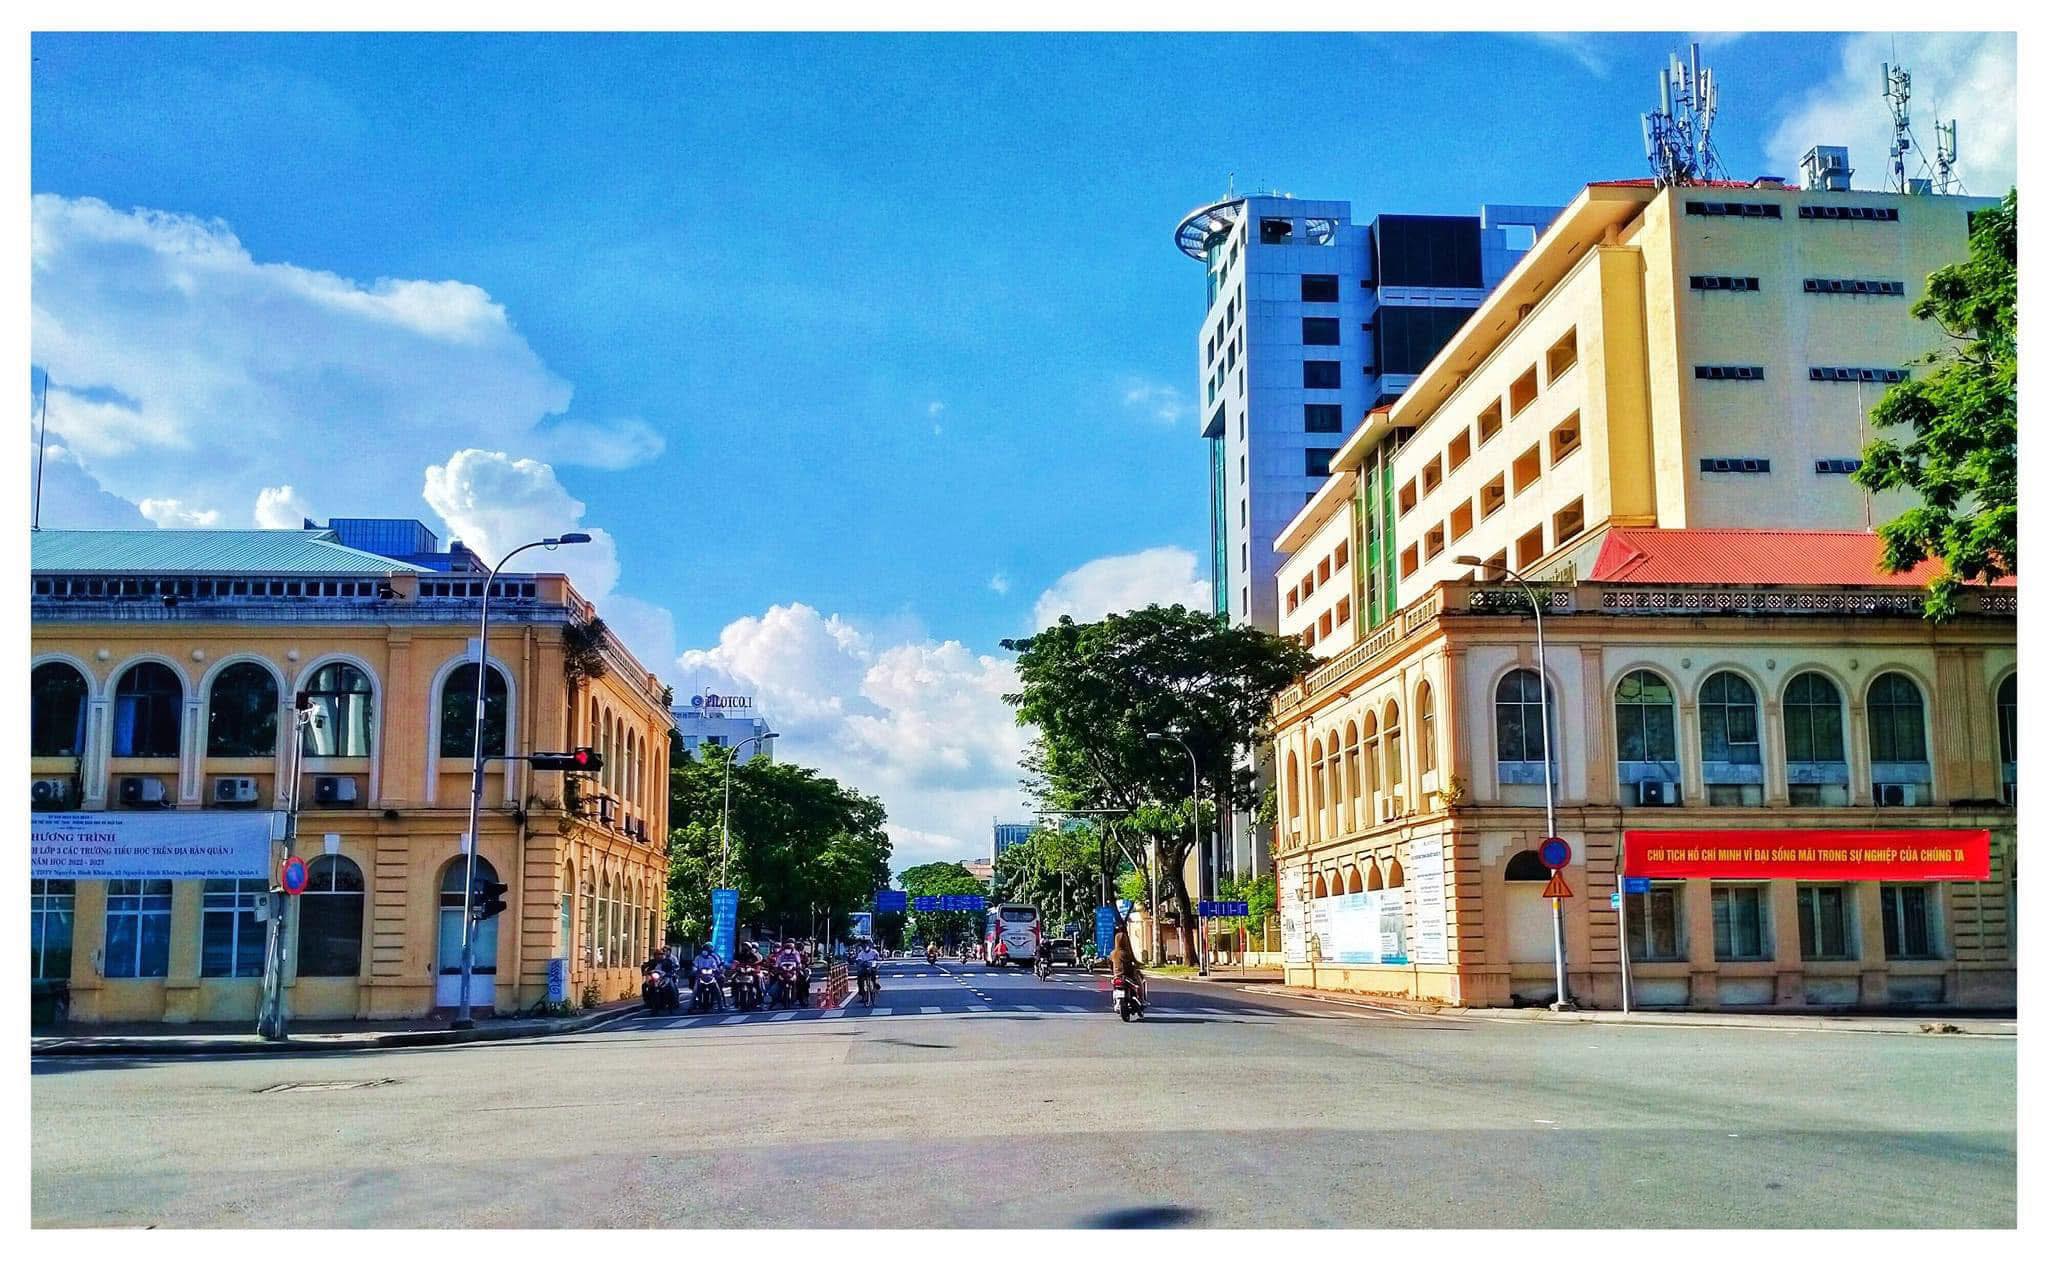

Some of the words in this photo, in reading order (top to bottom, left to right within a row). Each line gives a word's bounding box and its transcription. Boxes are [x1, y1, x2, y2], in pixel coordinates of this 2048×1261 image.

[77, 832, 116, 842] TRÌNH
[62, 845, 79, 855] CÁC
[152, 845, 173, 855] TRÊN
[1647, 845, 1665, 862] CHỦ
[1666, 848, 1686, 864] TỊCH
[1687, 844, 1699, 862] HỒ
[1701, 847, 1716, 862] CHÍ
[1718, 848, 1742, 862] MINH
[1743, 846, 1753, 862] VĨ
[1754, 848, 1770, 864] ĐẠI
[1771, 844, 1796, 862] SỐNG
[1798, 847, 1816, 862] MÃI
[1817, 848, 1848, 862] TRONG
[1849, 848, 1862, 864] SỰ
[1864, 847, 1898, 864] NGHIỆP
[1899, 845, 1919, 862] CỦA
[1920, 846, 1952, 862] CHÚNG
[1953, 849, 1965, 862] TA
[50, 857, 66, 866] HỌC
